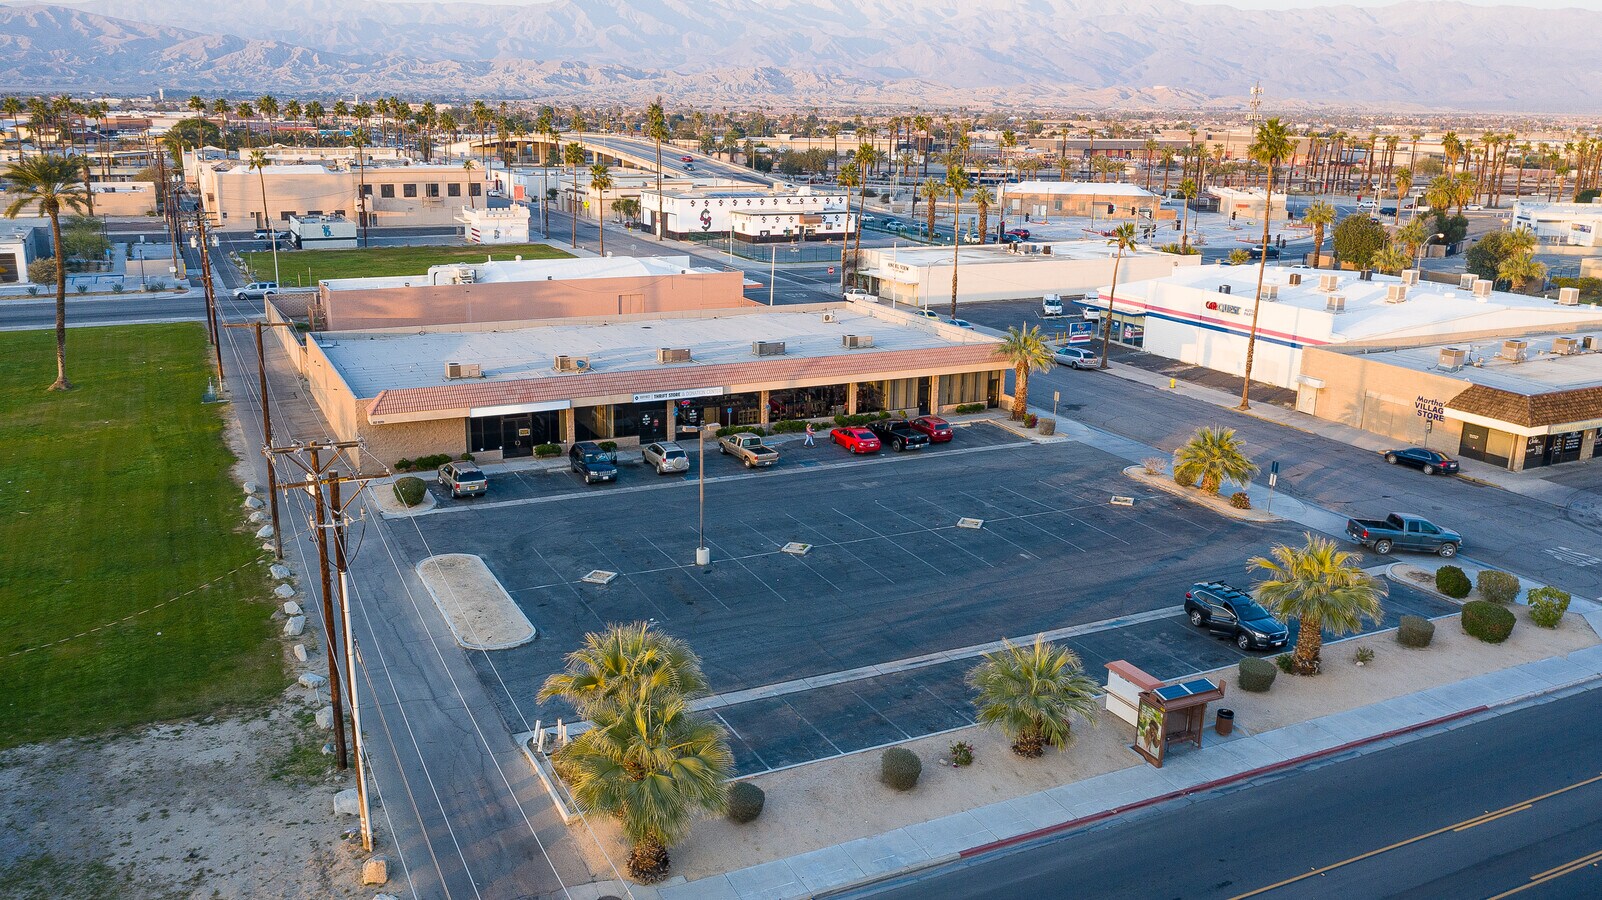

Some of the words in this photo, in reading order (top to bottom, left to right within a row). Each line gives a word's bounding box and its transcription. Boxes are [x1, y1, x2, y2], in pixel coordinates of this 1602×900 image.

[1415, 401, 1444, 414] VILLAG
[1416, 395, 1447, 407] Martha'
[1417, 409, 1445, 422] STORE
